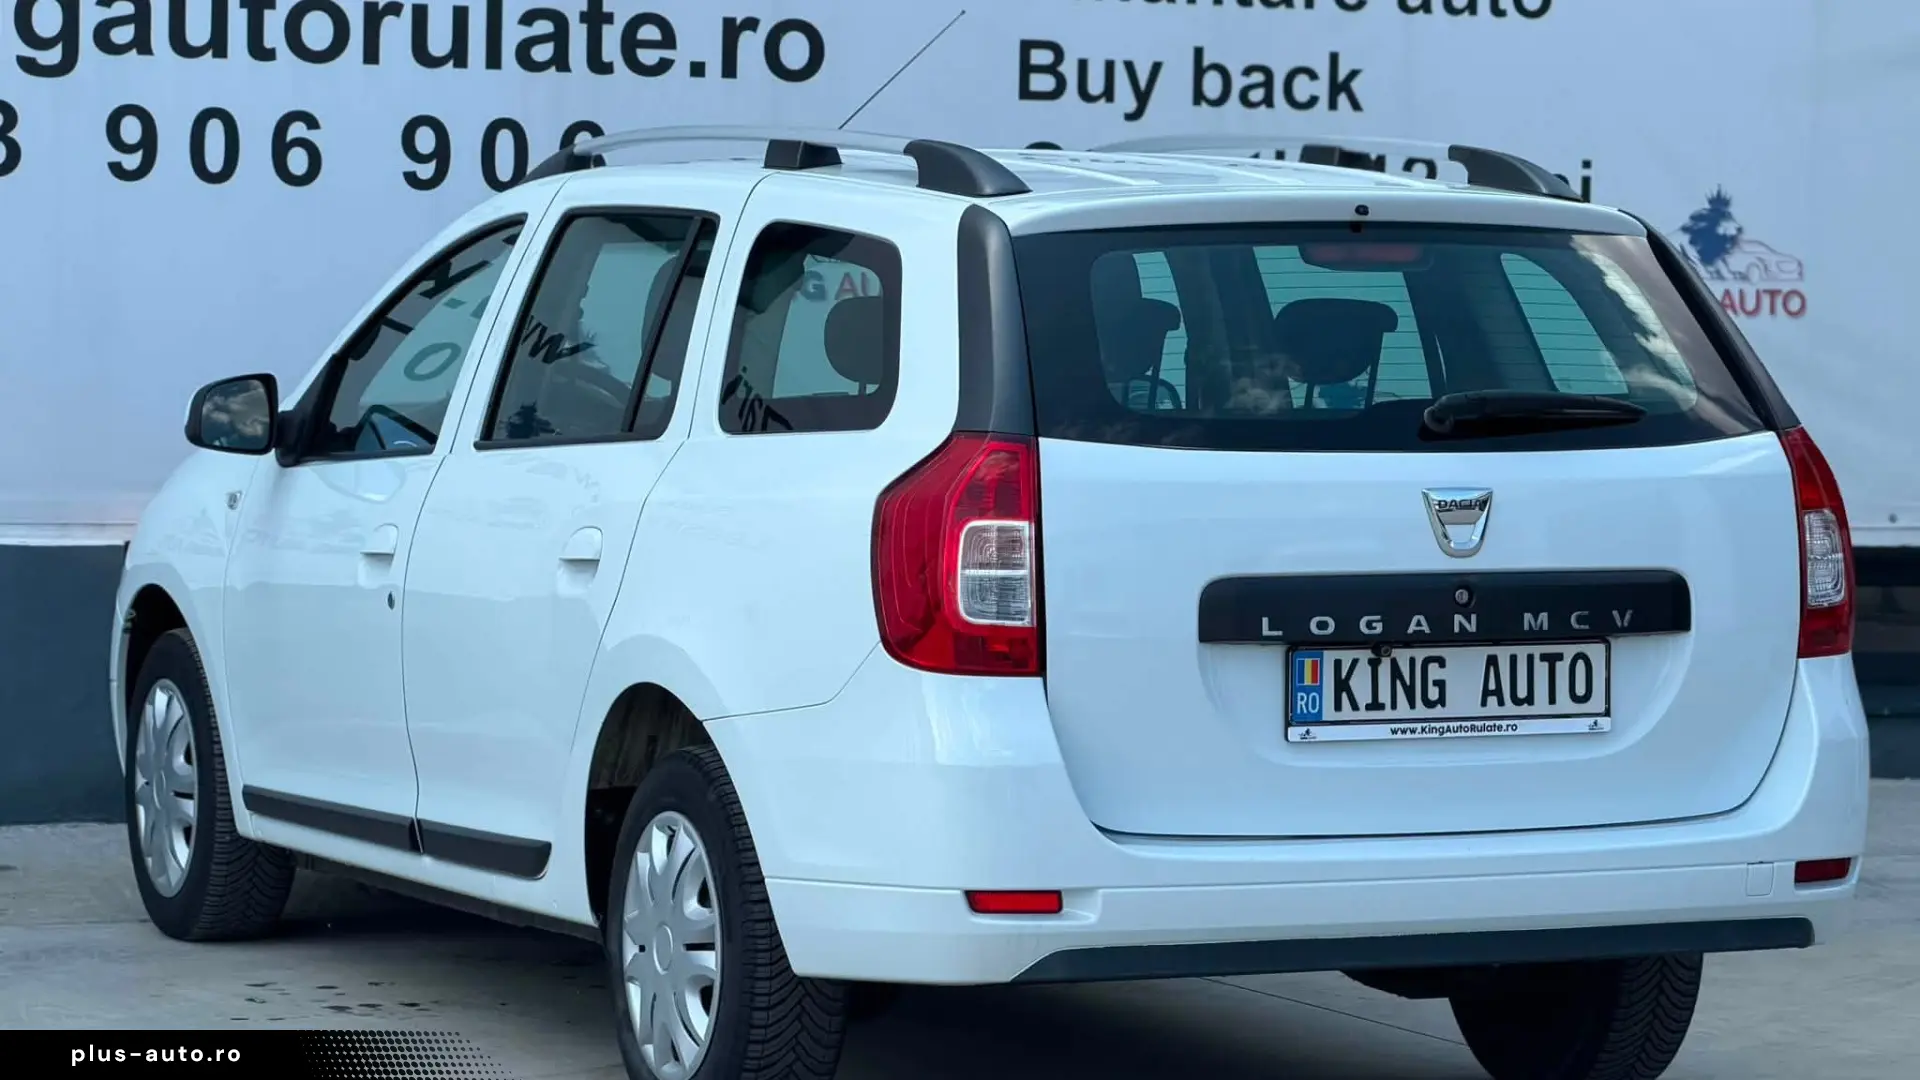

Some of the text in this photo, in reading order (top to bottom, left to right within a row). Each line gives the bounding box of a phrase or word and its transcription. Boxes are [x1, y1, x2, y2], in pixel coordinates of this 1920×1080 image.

[1018, 38, 1364, 122] Buy back
[105, 102, 323, 188] 906
[1719, 287, 1808, 319] AUTO
[1438, 499, 1485, 511] DACIA
[1261, 608, 1634, 637] LOGAN MCV
[1296, 651, 1594, 715] RO KING AUTO
[1390, 722, 1518, 738] www.KingAutoRulate.ro
